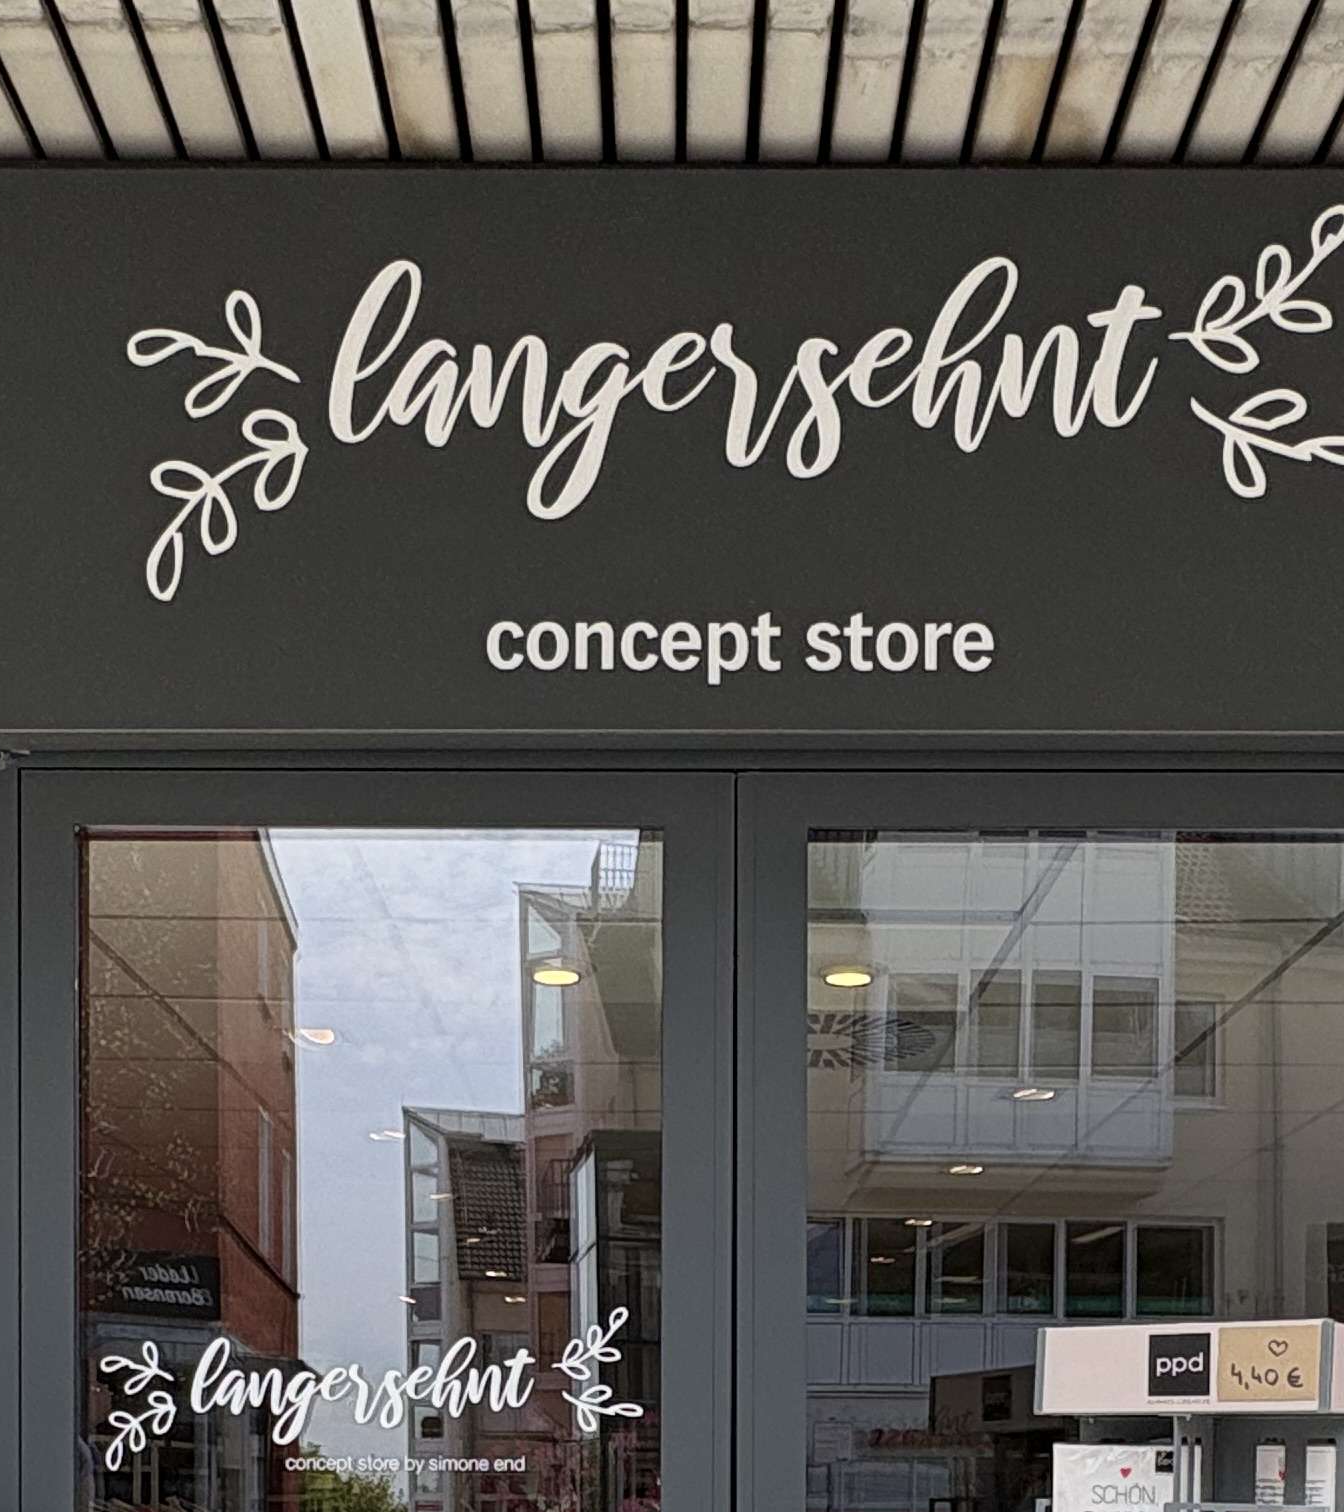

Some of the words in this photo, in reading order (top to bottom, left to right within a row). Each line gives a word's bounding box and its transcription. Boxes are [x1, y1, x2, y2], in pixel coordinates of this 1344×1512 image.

[328, 257, 1162, 519] langersehnt
[486, 614, 781, 685] concept
[804, 614, 995, 672] store
[1156, 1352, 1204, 1377] ppd
[1230, 1362, 1279, 1390] 4,40
[1286, 1366, 1305, 1389] €
[191, 1337, 535, 1446] langersehnt
[285, 1455, 353, 1473] concept
[357, 1455, 400, 1471] store
[404, 1455, 424, 1473] by
[428, 1455, 489, 1471] simone
[493, 1455, 526, 1471] end
